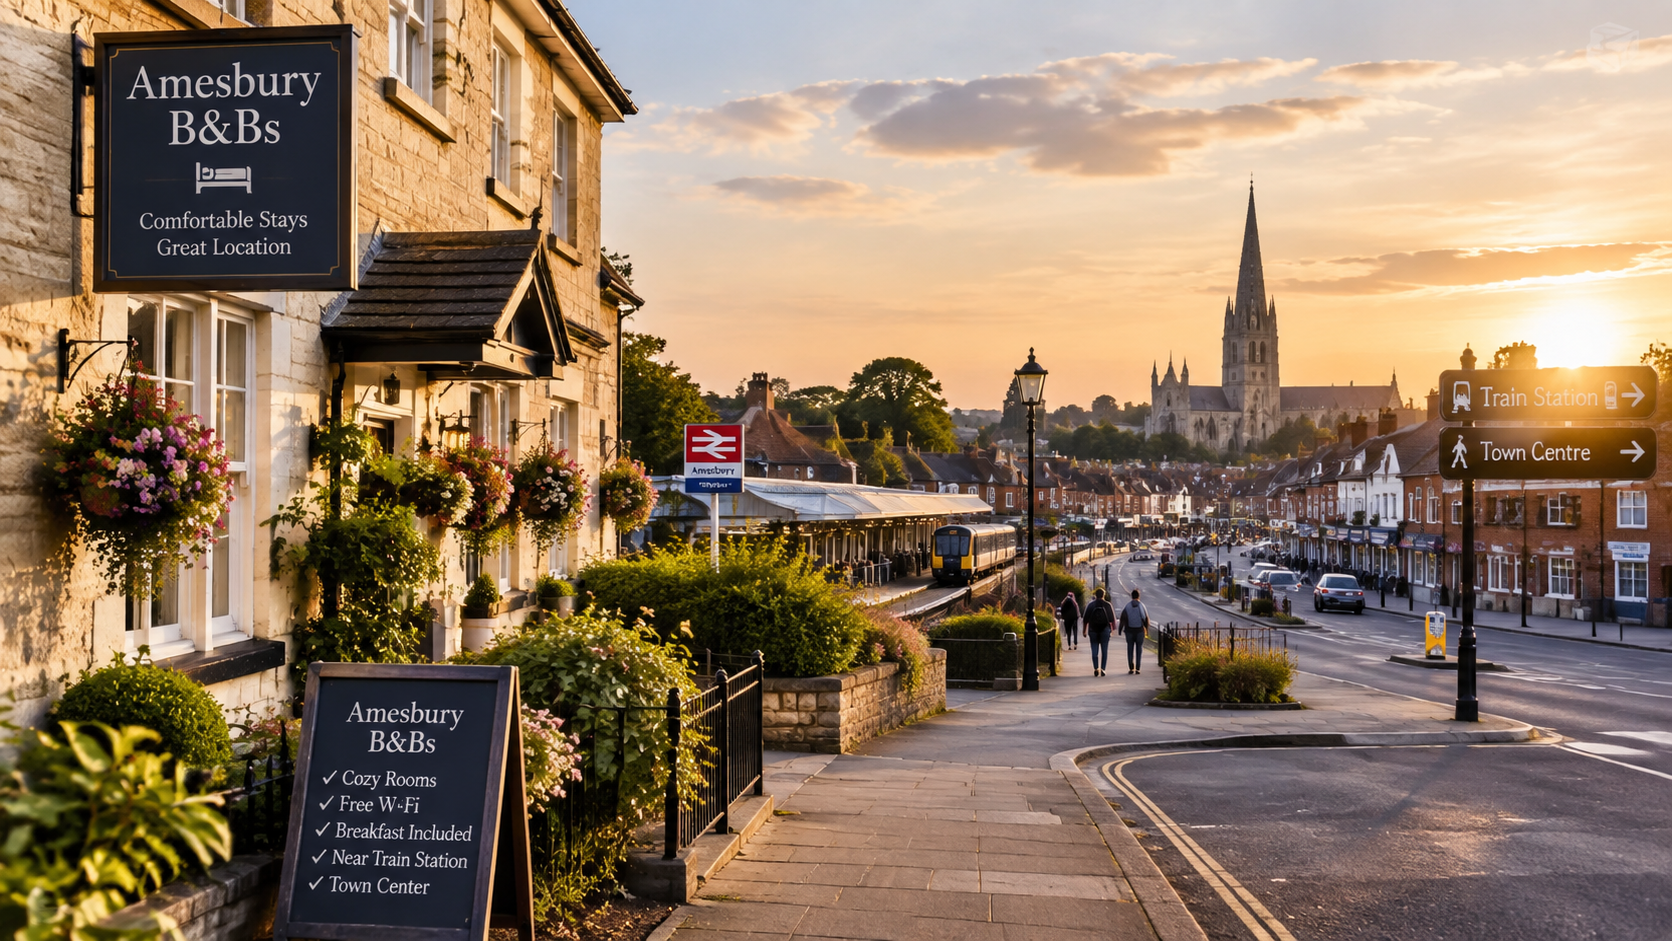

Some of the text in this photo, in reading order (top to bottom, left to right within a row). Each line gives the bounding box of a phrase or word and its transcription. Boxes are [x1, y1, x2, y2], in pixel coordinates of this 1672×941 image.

[126, 61, 322, 107] Amesbury
[168, 108, 281, 146] B&Bs
[139, 210, 308, 233] Comfortable Stays
[157, 237, 292, 257] Great Location
[1480, 386, 1598, 408] Train Station
[1480, 441, 1591, 462] Town Centre
[346, 701, 465, 731] Amesbury
[367, 730, 436, 754] B&Bs
[342, 769, 437, 791] Cozy Rooms
[339, 795, 374, 813] Free
[335, 822, 472, 842] Breakfast Included
[331, 849, 468, 869] Near Train Station
[329, 876, 430, 895] Town Center
